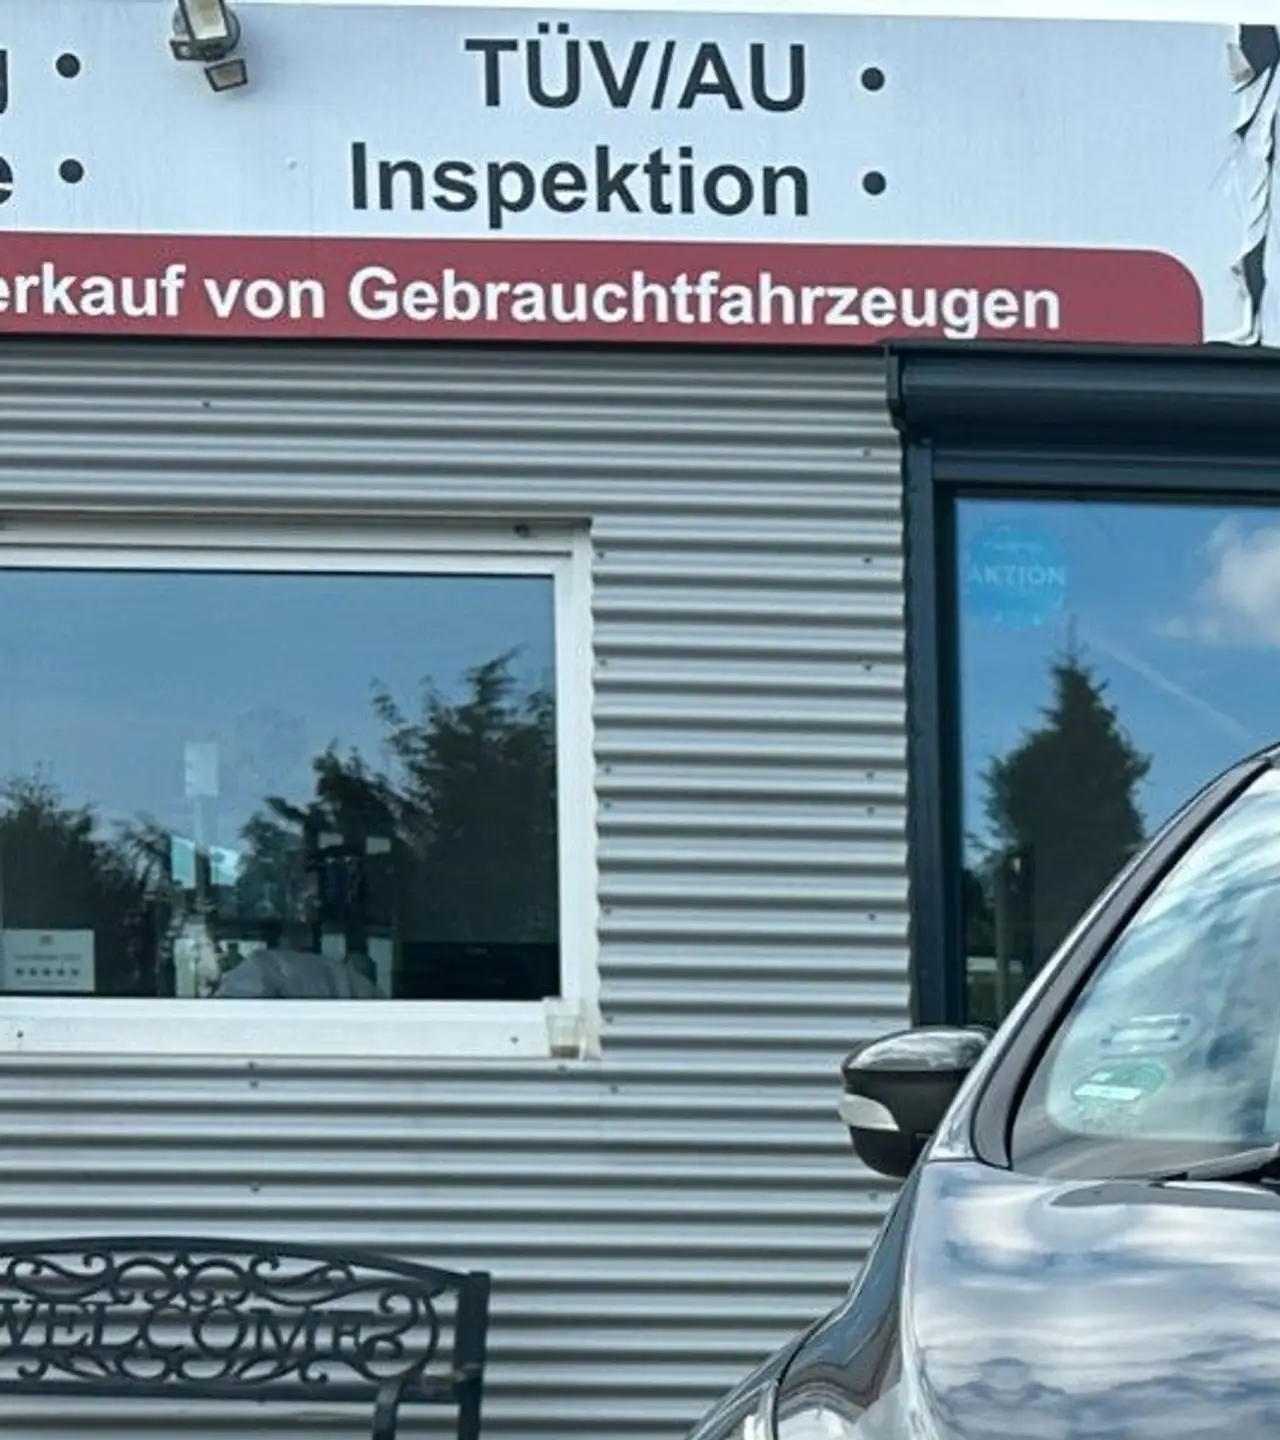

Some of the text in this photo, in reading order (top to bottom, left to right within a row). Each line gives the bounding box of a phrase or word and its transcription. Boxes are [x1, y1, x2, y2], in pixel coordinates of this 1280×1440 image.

[464, 22, 806, 113] TÜV/AU
[351, 141, 809, 230] Inspektion
[204, 278, 325, 319] von
[348, 266, 1060, 339] Gebrauchtfahrzeugen
